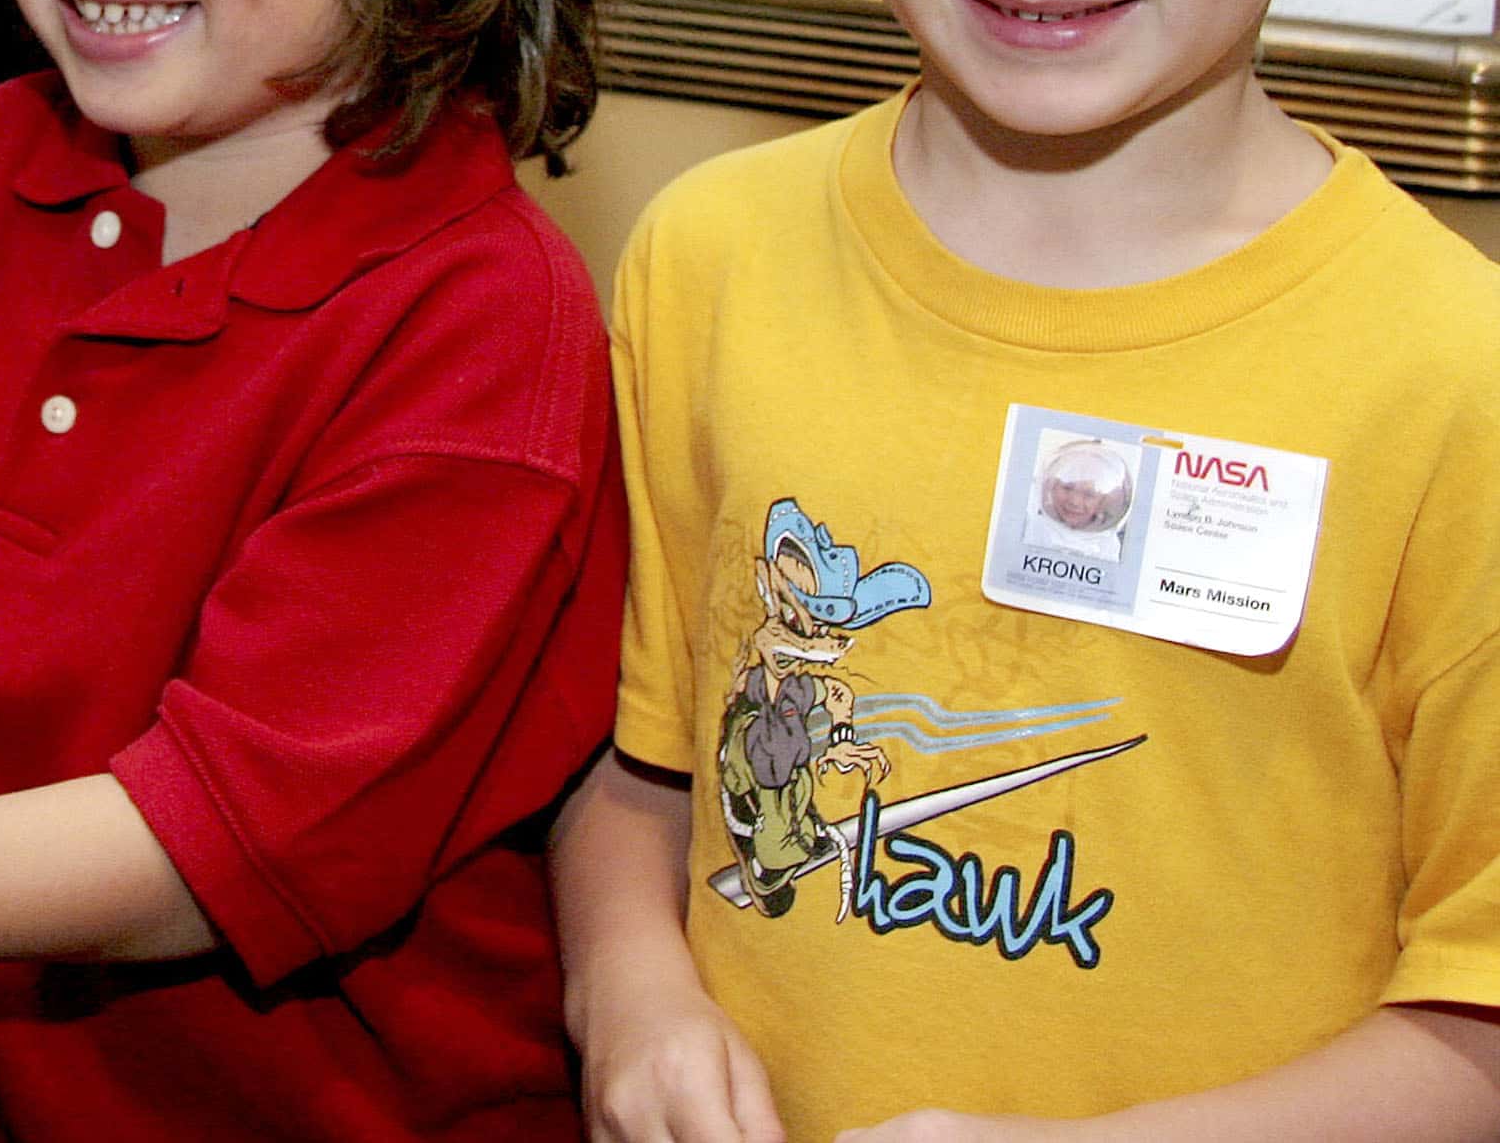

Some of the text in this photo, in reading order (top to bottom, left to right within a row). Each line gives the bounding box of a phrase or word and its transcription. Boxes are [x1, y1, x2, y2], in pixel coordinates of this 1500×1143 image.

[1174, 451, 1269, 492] NASA
[1022, 554, 1102, 586] KRONG
[1159, 578, 1202, 600] Mars
[1206, 587, 1272, 613] Mission
